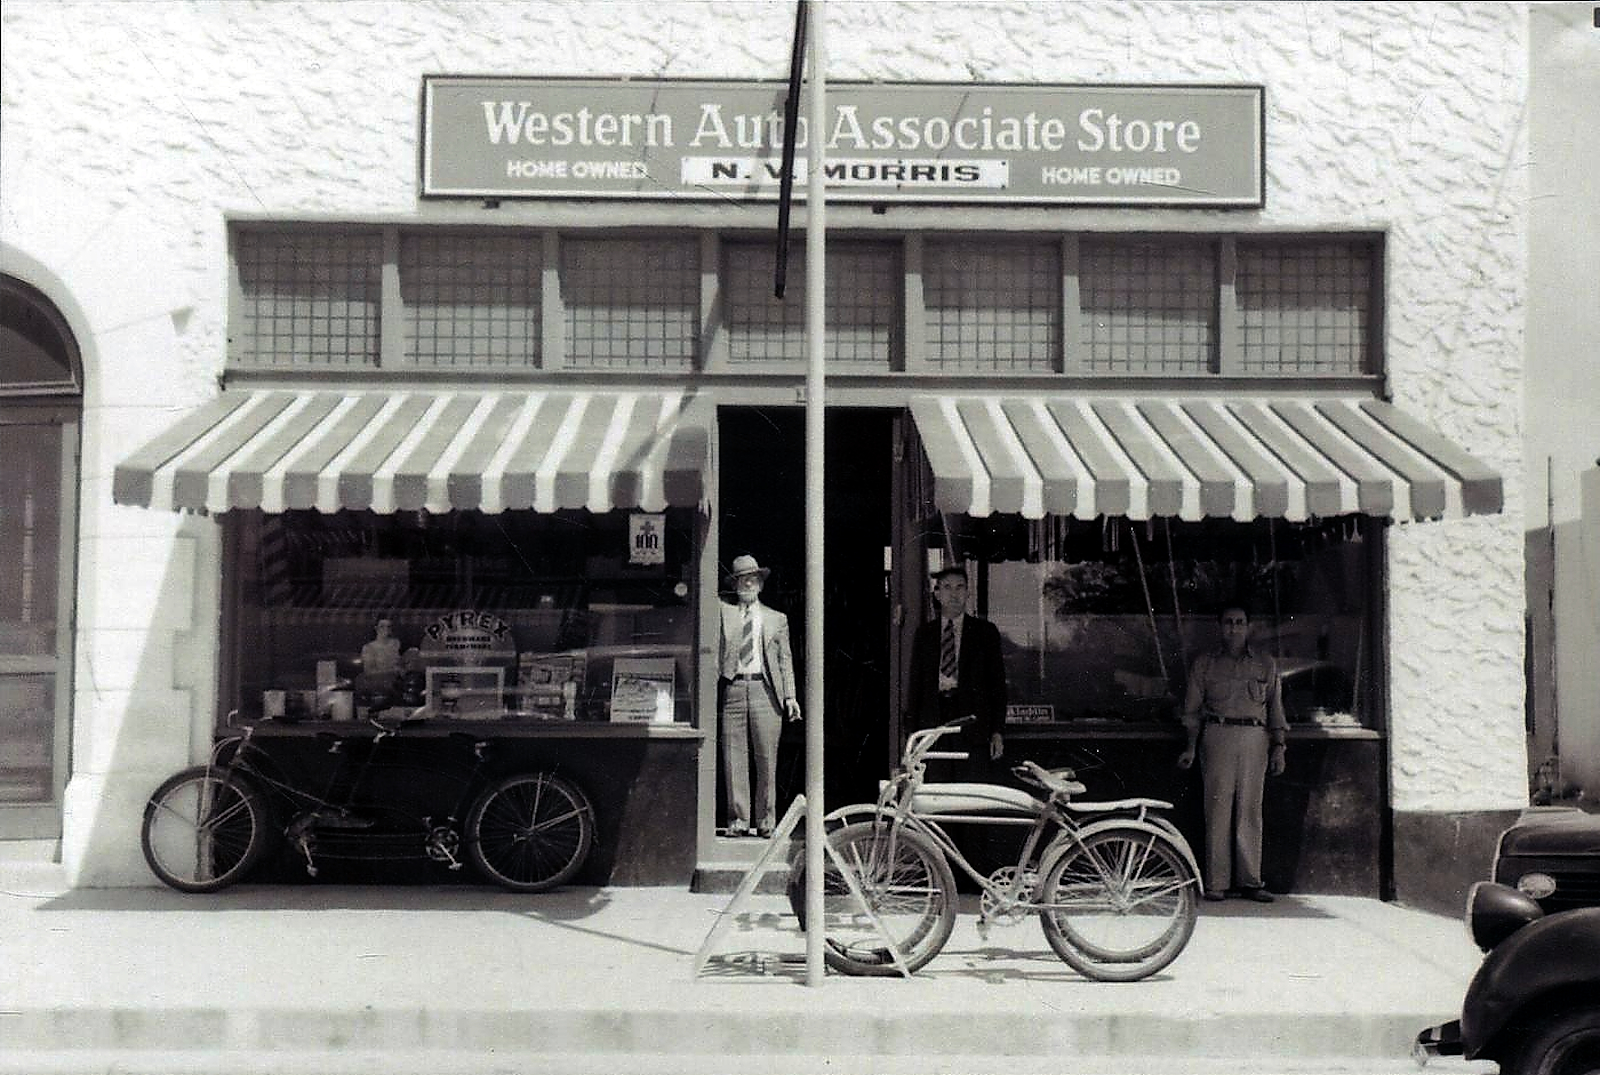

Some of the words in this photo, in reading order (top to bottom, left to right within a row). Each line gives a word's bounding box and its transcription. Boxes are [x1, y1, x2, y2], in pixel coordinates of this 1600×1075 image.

[481, 101, 674, 147] Western
[826, 104, 1065, 152] Associate
[1078, 108, 1201, 153] Store
[507, 159, 567, 178] HOME
[572, 160, 647, 179] OWNED
[1041, 167, 1100, 185] HOME
[1105, 167, 1181, 186] OWNED
[425, 609, 511, 641] PYREX
